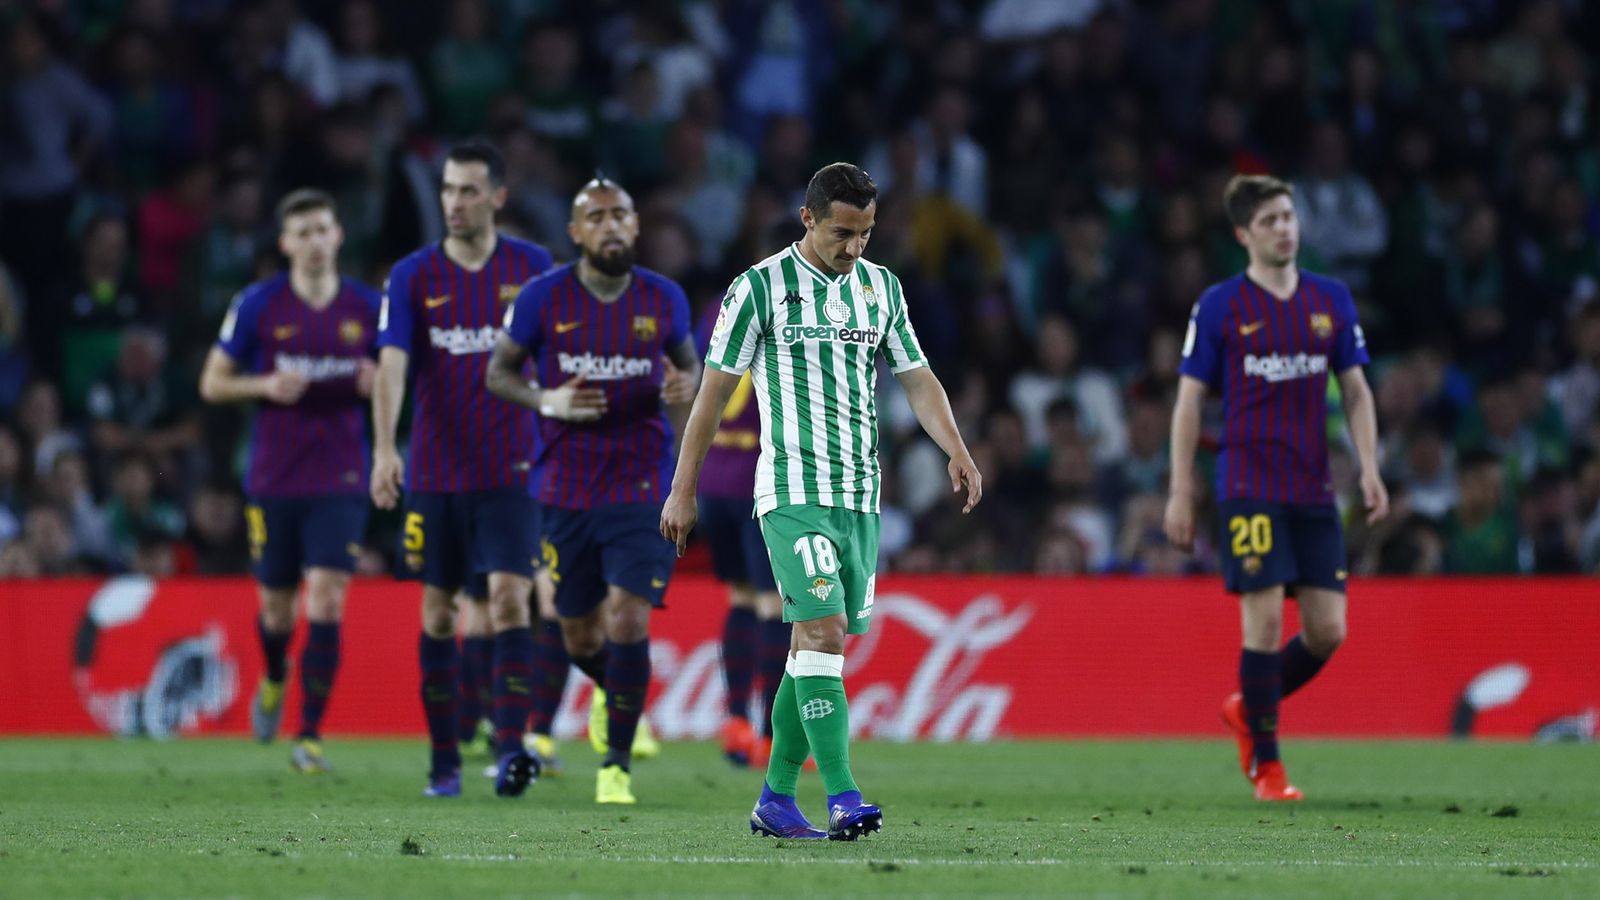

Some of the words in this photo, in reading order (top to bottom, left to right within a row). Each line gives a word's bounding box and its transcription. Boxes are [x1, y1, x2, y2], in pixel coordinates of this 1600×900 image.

[429, 325, 503, 353] Rakute
[558, 352, 652, 379] Rakuten
[1243, 353, 1328, 381] Rakuten
[404, 511, 425, 550] 5
[1229, 513, 1273, 557] 20
[793, 534, 836, 578] 18
